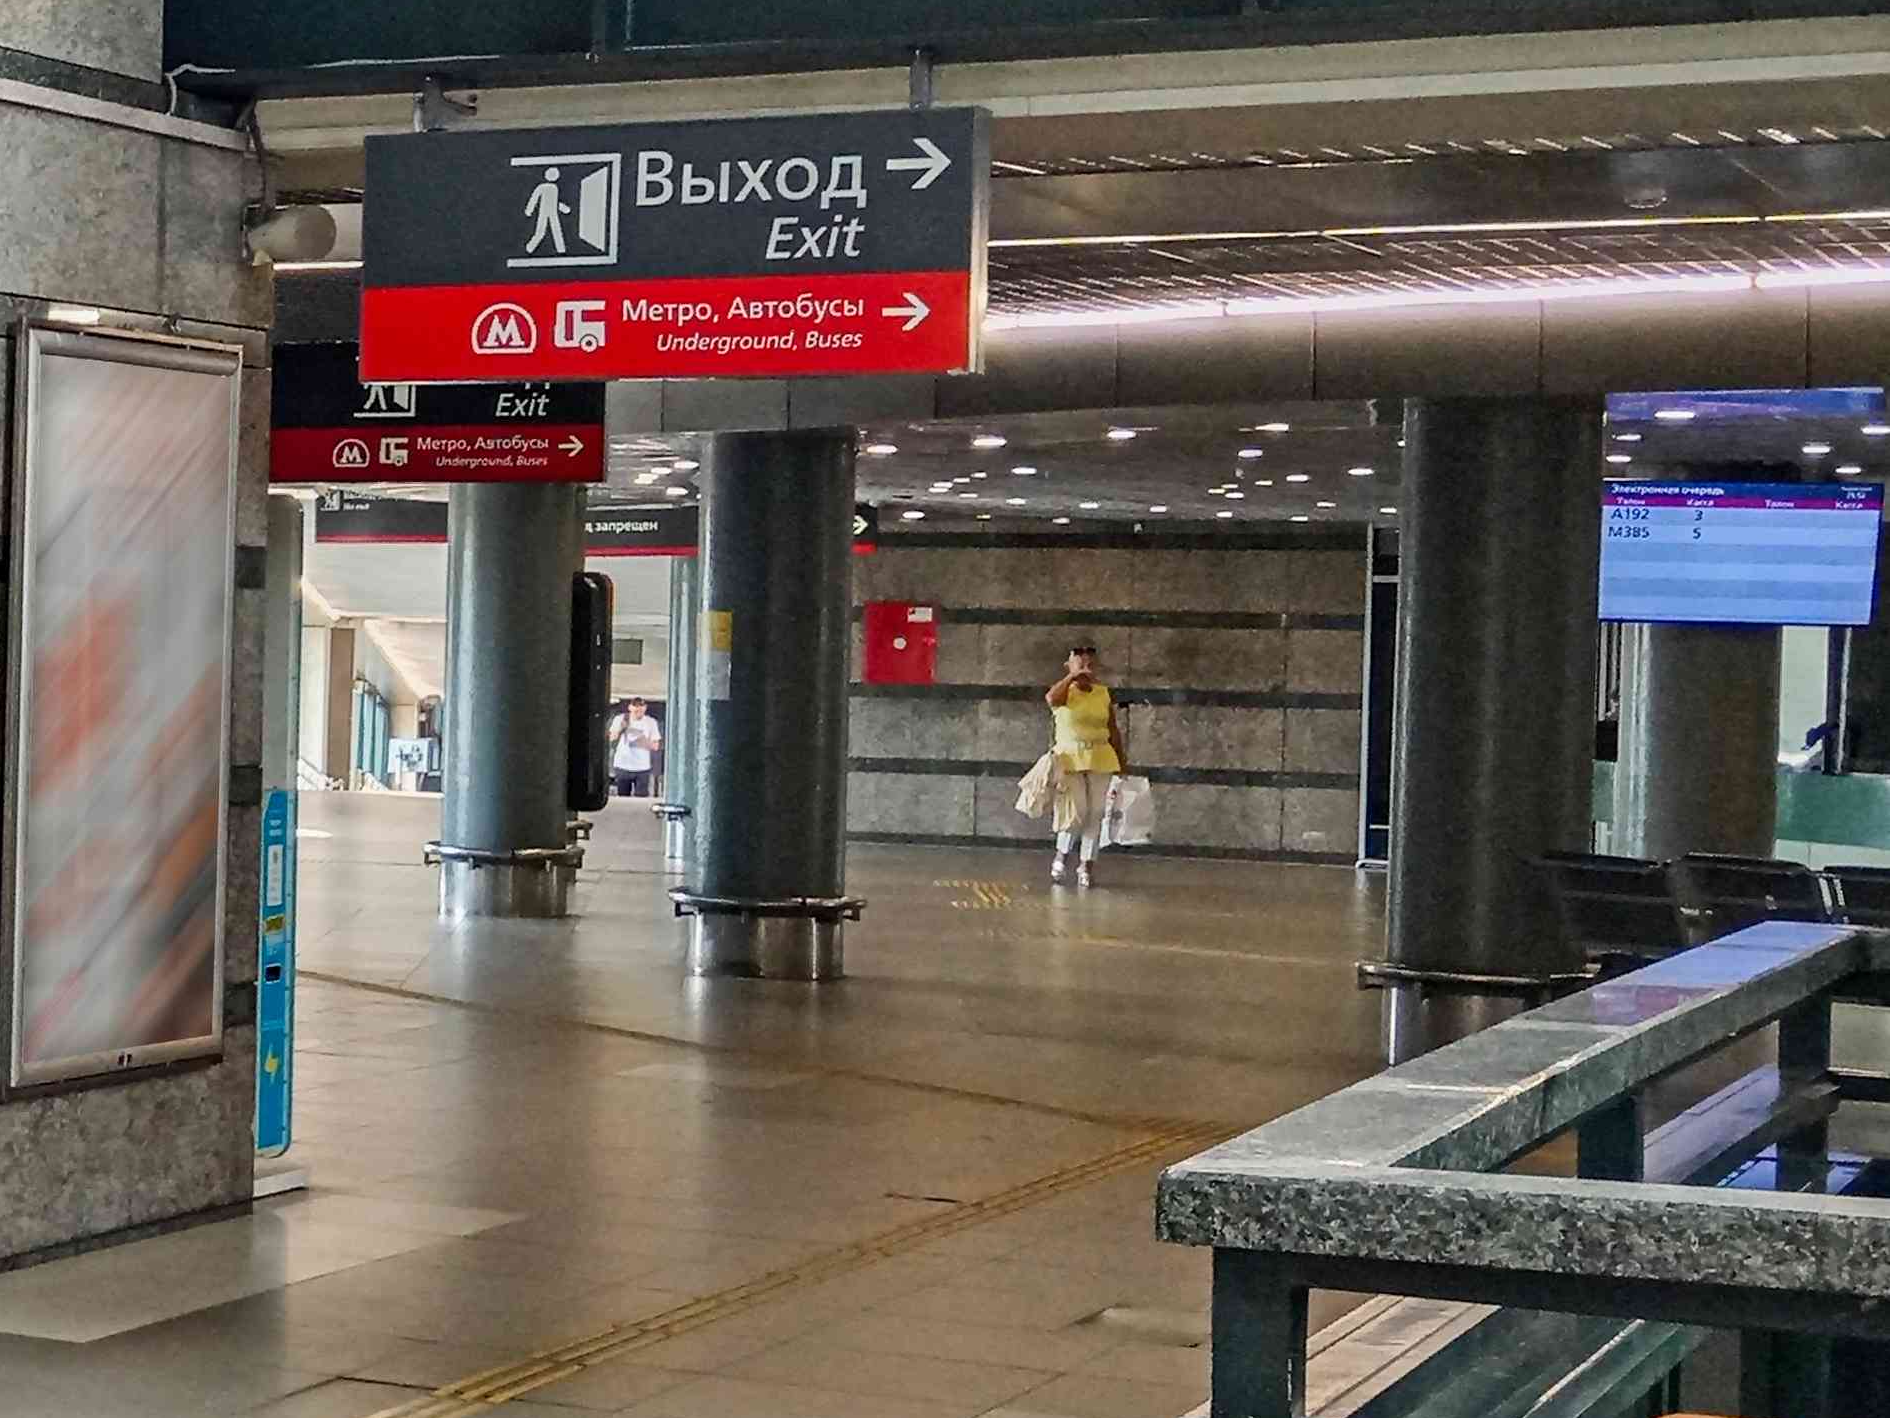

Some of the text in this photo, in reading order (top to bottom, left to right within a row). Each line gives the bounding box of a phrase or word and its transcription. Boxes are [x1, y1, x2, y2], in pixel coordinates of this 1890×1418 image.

[633, 149, 869, 208] Выход
[764, 214, 866, 263] Exit
[622, 292, 866, 327] Метро, Автобусы
[656, 327, 864, 353] Underground, Buses
[495, 391, 551, 418] Exit
[417, 434, 550, 452] Метро, Автобусы
[435, 454, 549, 469] Underground, Buses
[594, 521, 659, 534] запрещен
